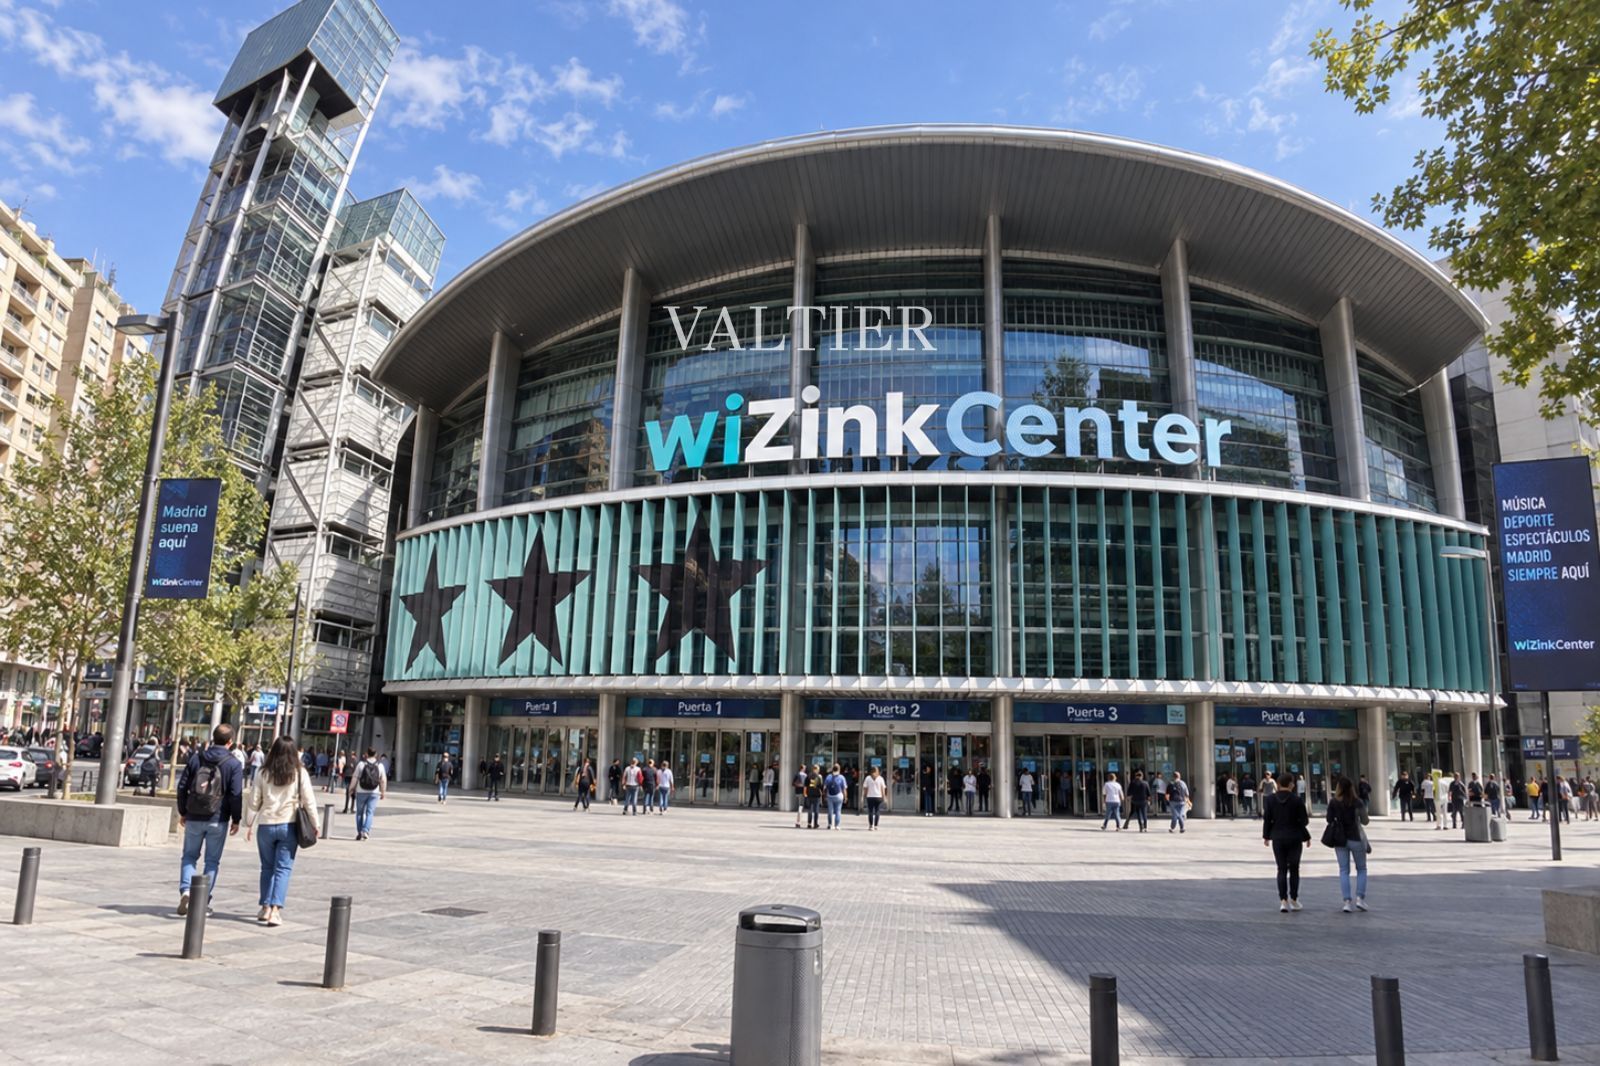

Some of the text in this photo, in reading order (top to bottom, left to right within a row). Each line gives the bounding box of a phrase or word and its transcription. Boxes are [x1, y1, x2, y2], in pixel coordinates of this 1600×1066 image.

[162, 505, 208, 518] Madrid
[1502, 496, 1546, 512] MÚSICA
[160, 523, 199, 533] suena
[1503, 513, 1555, 530] DEPORTE
[1505, 529, 1590, 546] ESPECTÁCULOS
[1506, 549, 1552, 564] MADRID
[1508, 562, 1590, 582] SIEMPRE AQUÍ
[525, 701, 558, 714] Puerta 1
[678, 701, 722, 716] Puerta 1
[868, 703, 921, 718] Puerta 2
[1067, 706, 1118, 721] Puerta 3
[1261, 710, 1306, 725] Puerta 4
